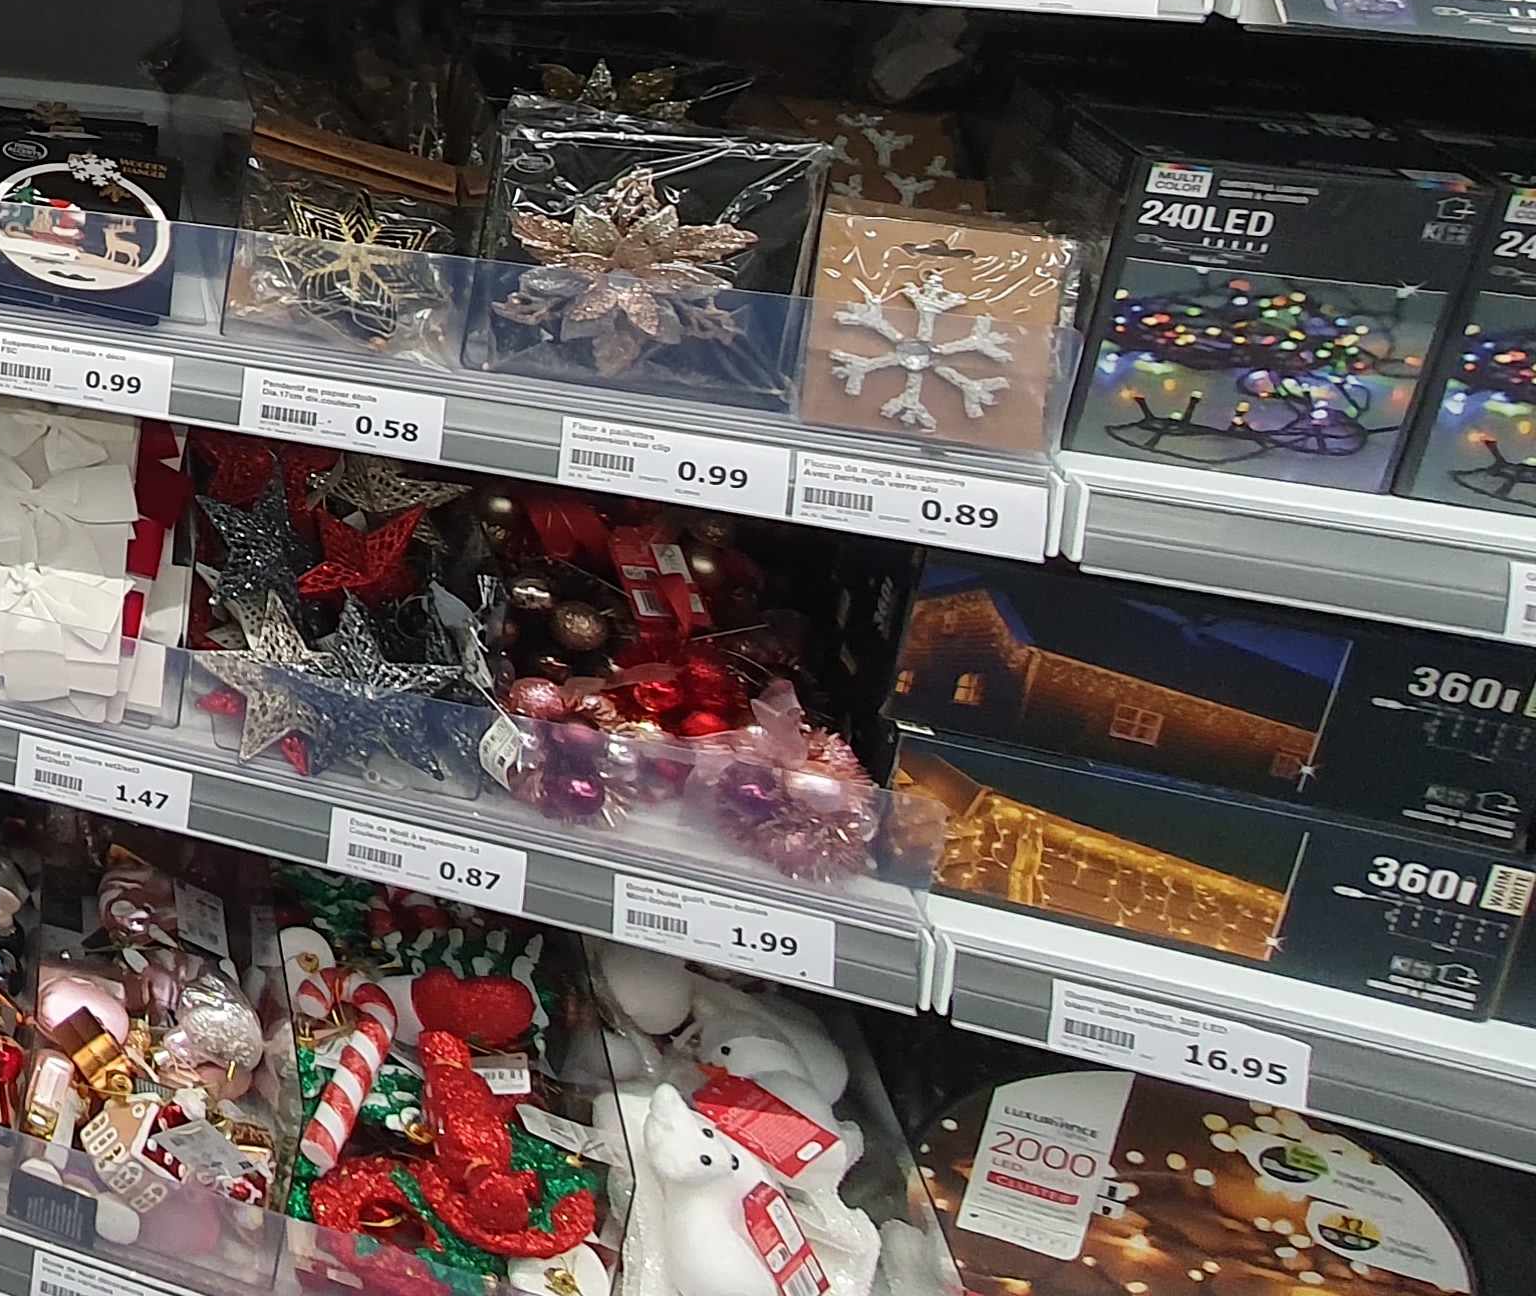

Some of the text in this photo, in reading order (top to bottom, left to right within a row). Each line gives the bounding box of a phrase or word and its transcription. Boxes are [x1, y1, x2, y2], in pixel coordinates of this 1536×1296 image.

[1154, 180, 1202, 193] COLOR
[1157, 170, 1205, 183] MULTI
[1136, 200, 1277, 239] 240LED
[0, 346, 18, 355] FSC
[85, 369, 142, 395] 0.99
[355, 415, 419, 443] 0.58
[571, 432, 672, 454] suspension sur clip
[572, 422, 598, 434] Fleur
[609, 427, 655, 442] paillettes
[678, 460, 748, 488] 0.99
[802, 467, 830, 479] Avec
[834, 472, 868, 485] perles
[921, 499, 998, 529] 0.89
[114, 783, 170, 811] 1.47
[438, 860, 501, 891] 0.87
[730, 926, 799, 957] 1.99
[1183, 1043, 1289, 1086] 16.95
[989, 1130, 1098, 1179] 2000
